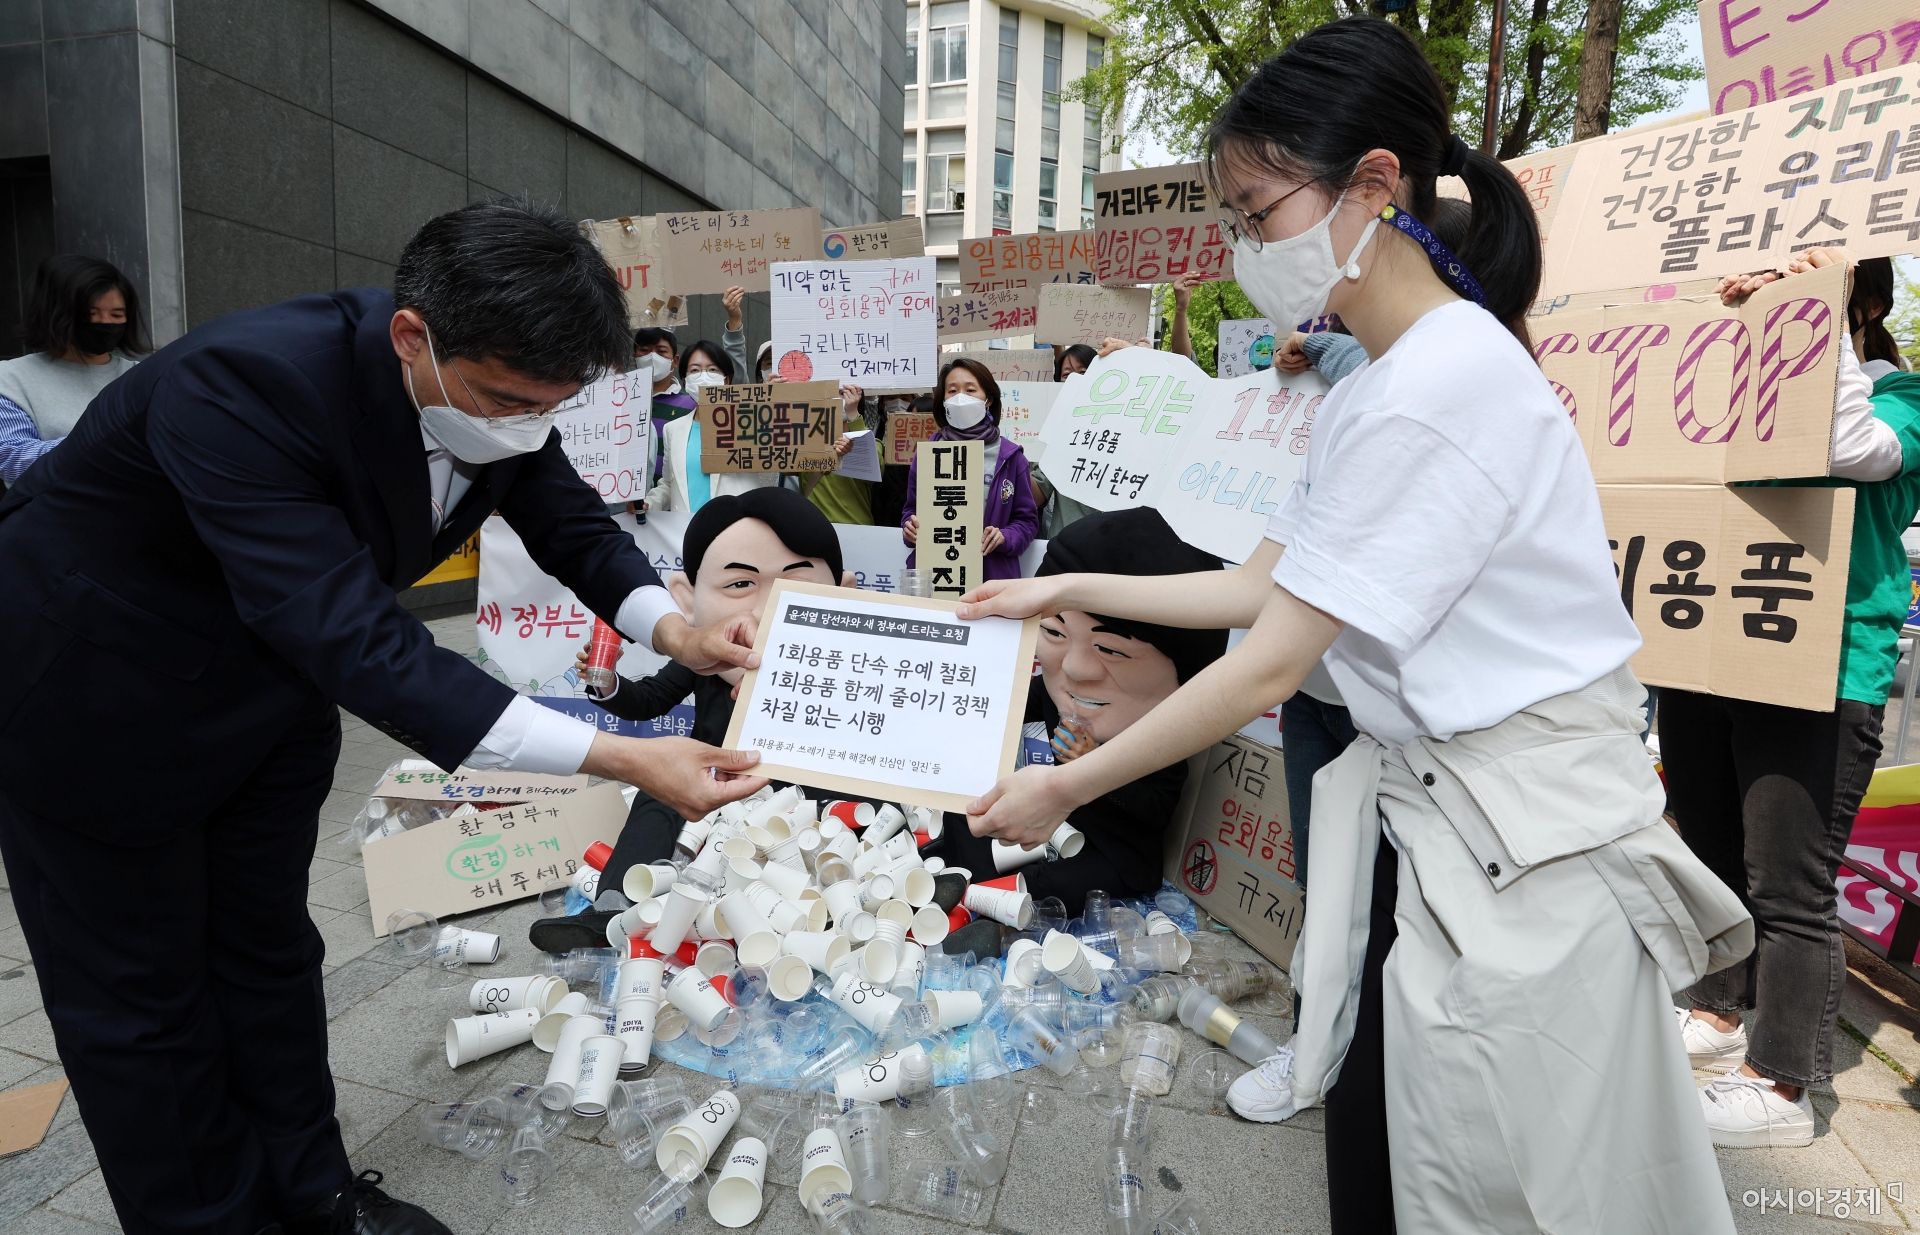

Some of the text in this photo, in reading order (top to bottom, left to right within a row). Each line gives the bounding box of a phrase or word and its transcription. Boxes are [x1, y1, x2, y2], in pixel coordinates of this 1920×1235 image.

[1620, 75, 1920, 182] 건강한 지구
[1602, 167, 1741, 232] 건강한
[666, 216, 701, 236] 만드는
[708, 214, 721, 232] 데
[701, 237, 747, 255] 사용하는
[750, 233, 765, 251] 데
[851, 232, 890, 253] 환경부
[720, 258, 743, 277] 썩어
[969, 235, 1065, 279] 일회용컵
[774, 268, 852, 295] 기약 없는
[883, 267, 921, 289] 규제
[818, 293, 936, 320] 일회용컵 유예
[799, 332, 891, 355] 코로나 핑계
[840, 356, 917, 378] 언제까지
[705, 384, 774, 404] 핑계는 그만!
[1071, 367, 1196, 437] 우리는
[711, 401, 837, 450] 일회용품규제
[1068, 428, 1123, 455] 1회용품
[726, 446, 799, 471] 지금 당장!
[1070, 457, 1150, 500] 규제 환영
[475, 600, 589, 640] 새 정부는
[788, 609, 965, 643] 윤석열 당선자와 새 정부에 드리는 요청
[777, 643, 978, 687] 1회용품 단속 유예 철회
[770, 670, 990, 719] 1회용품 함께 줄이기 정책
[760, 697, 886, 736] 차질 없는 시행
[751, 737, 795, 753] 1회용품과
[795, 743, 825, 758] 쓰레기
[826, 747, 847, 762] 문제
[848, 750, 877, 766] 해결에
[878, 754, 906, 771] 진심인
[394, 772, 470, 784] 환경부가
[1212, 740, 1271, 800] 지금
[441, 783, 522, 798] 환경하게
[1218, 798, 1296, 881] 일회용품
[1237, 870, 1296, 941] 규제
[620, 1025, 645, 1034] COFFEE
[622, 1018, 643, 1028] EDIYA
